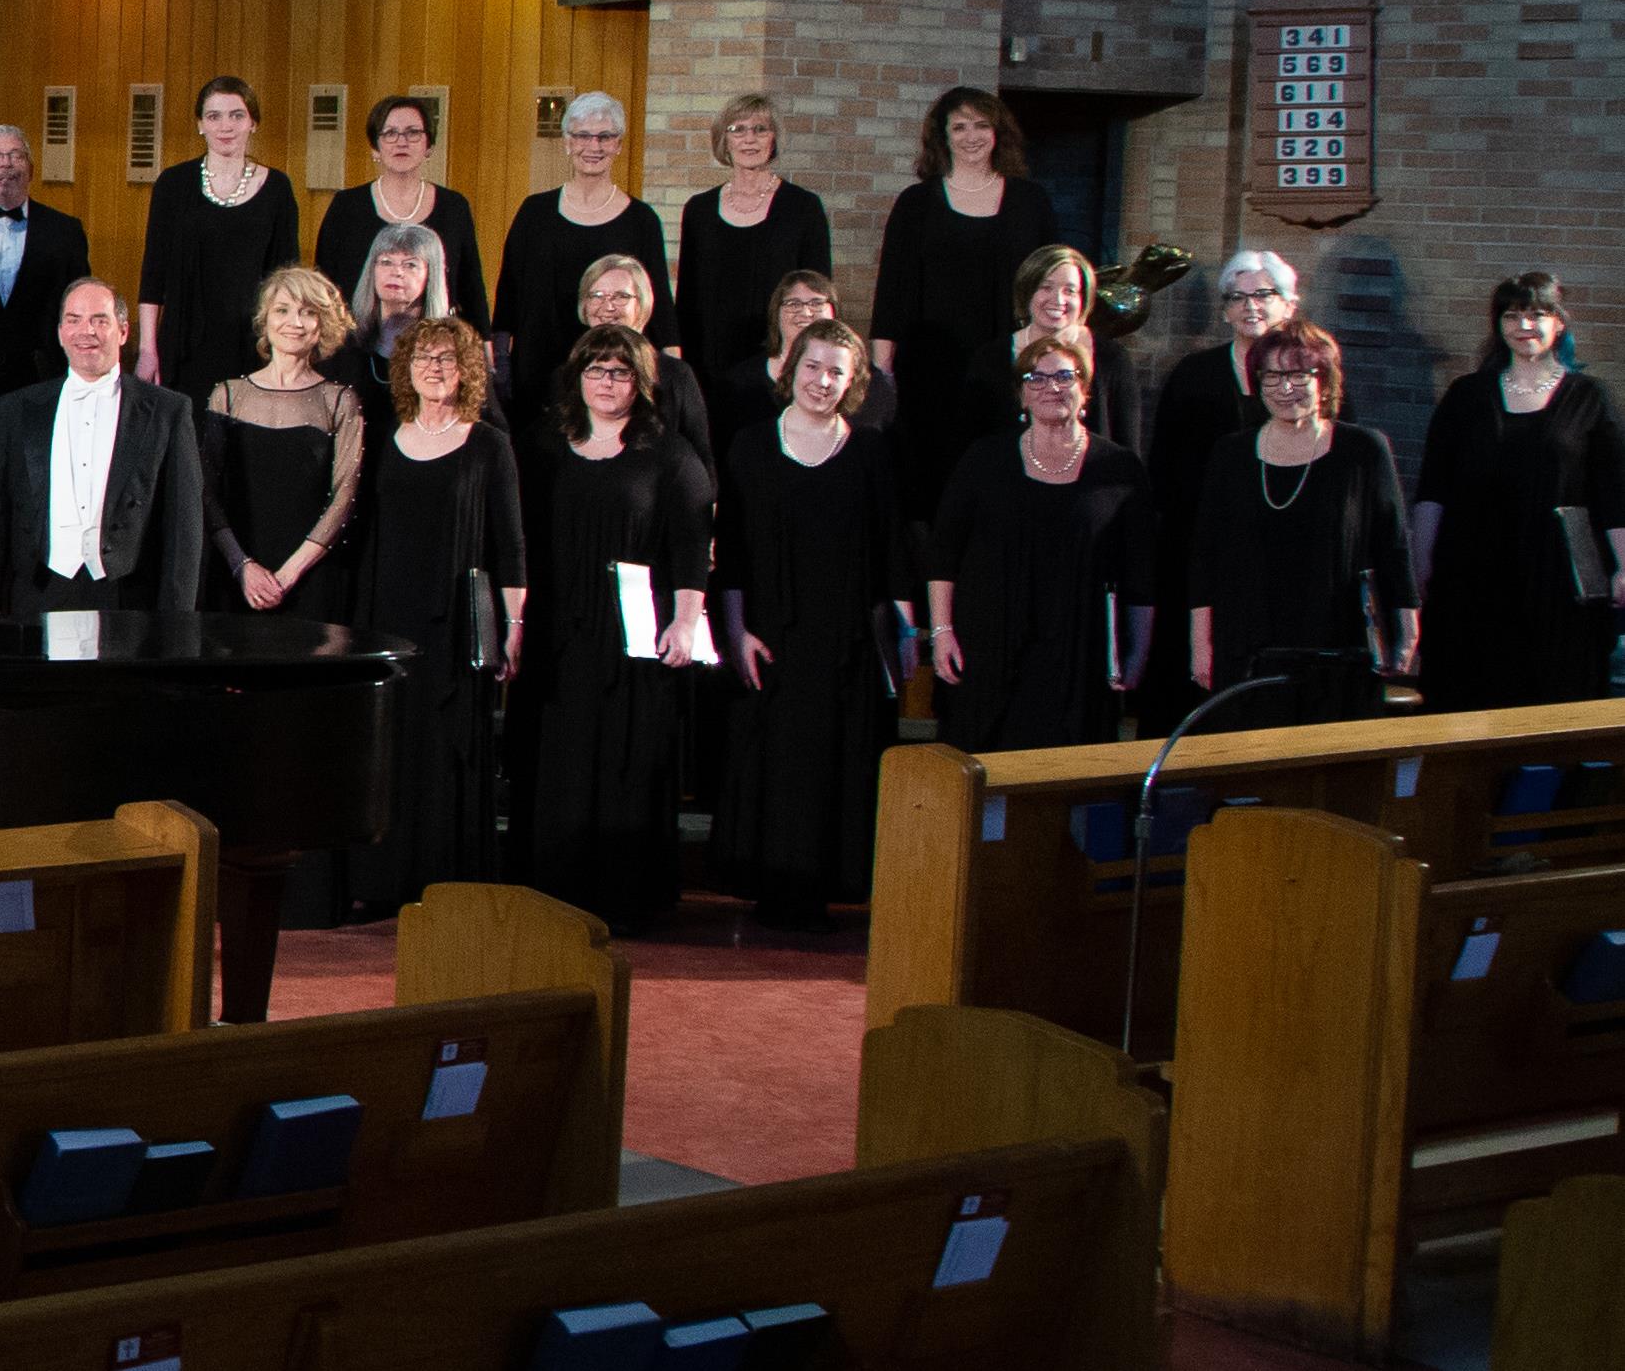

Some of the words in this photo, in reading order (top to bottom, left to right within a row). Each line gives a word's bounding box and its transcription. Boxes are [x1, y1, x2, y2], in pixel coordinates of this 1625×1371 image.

[1286, 27, 1343, 46] 341
[1282, 56, 1344, 74] 569
[1281, 84, 1336, 102] 611
[1285, 111, 1344, 130] 184
[1281, 139, 1343, 157] 520
[1283, 167, 1344, 185] 399
